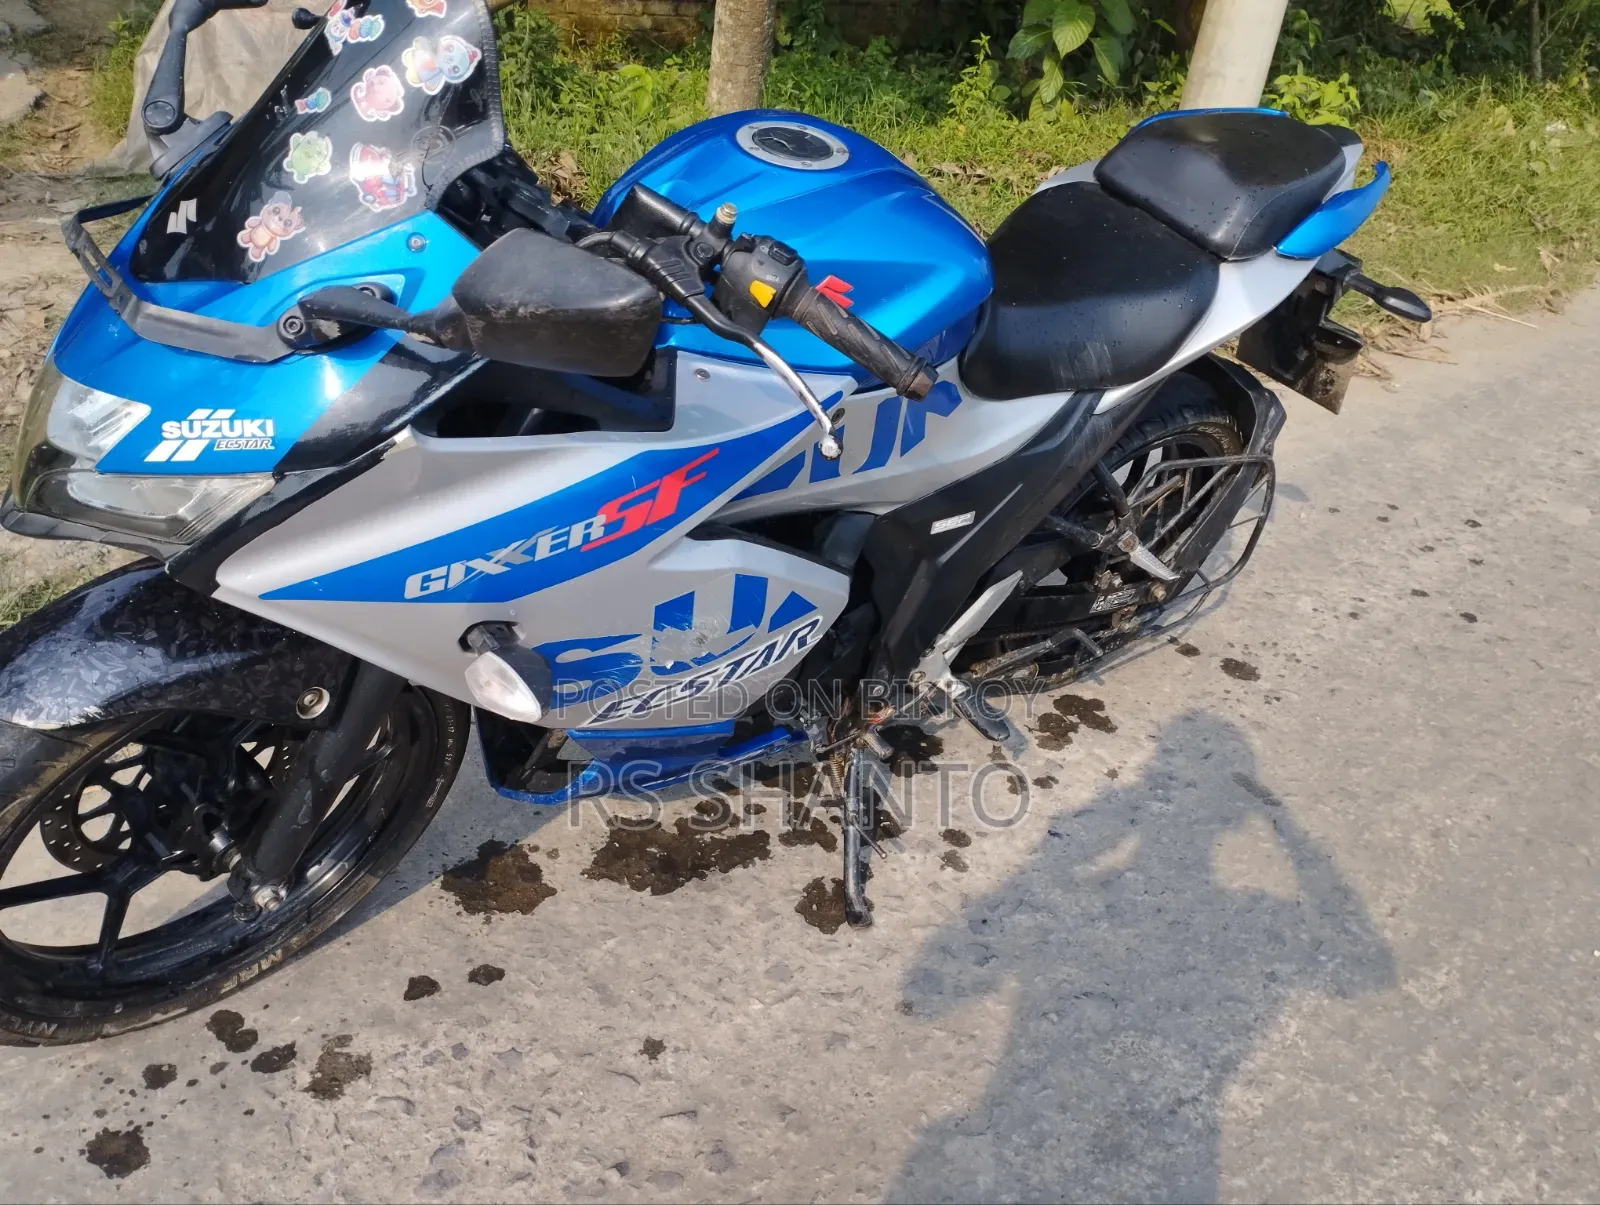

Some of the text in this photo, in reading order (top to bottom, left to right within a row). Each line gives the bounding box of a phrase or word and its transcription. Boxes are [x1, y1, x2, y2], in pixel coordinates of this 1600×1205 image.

[161, 419, 275, 439] SUZUKI
[215, 438, 273, 450] ECSTAR
[404, 447, 720, 600] GIXXER SF
[931, 512, 974, 532] SEP
[579, 615, 823, 727] ECSTAR
